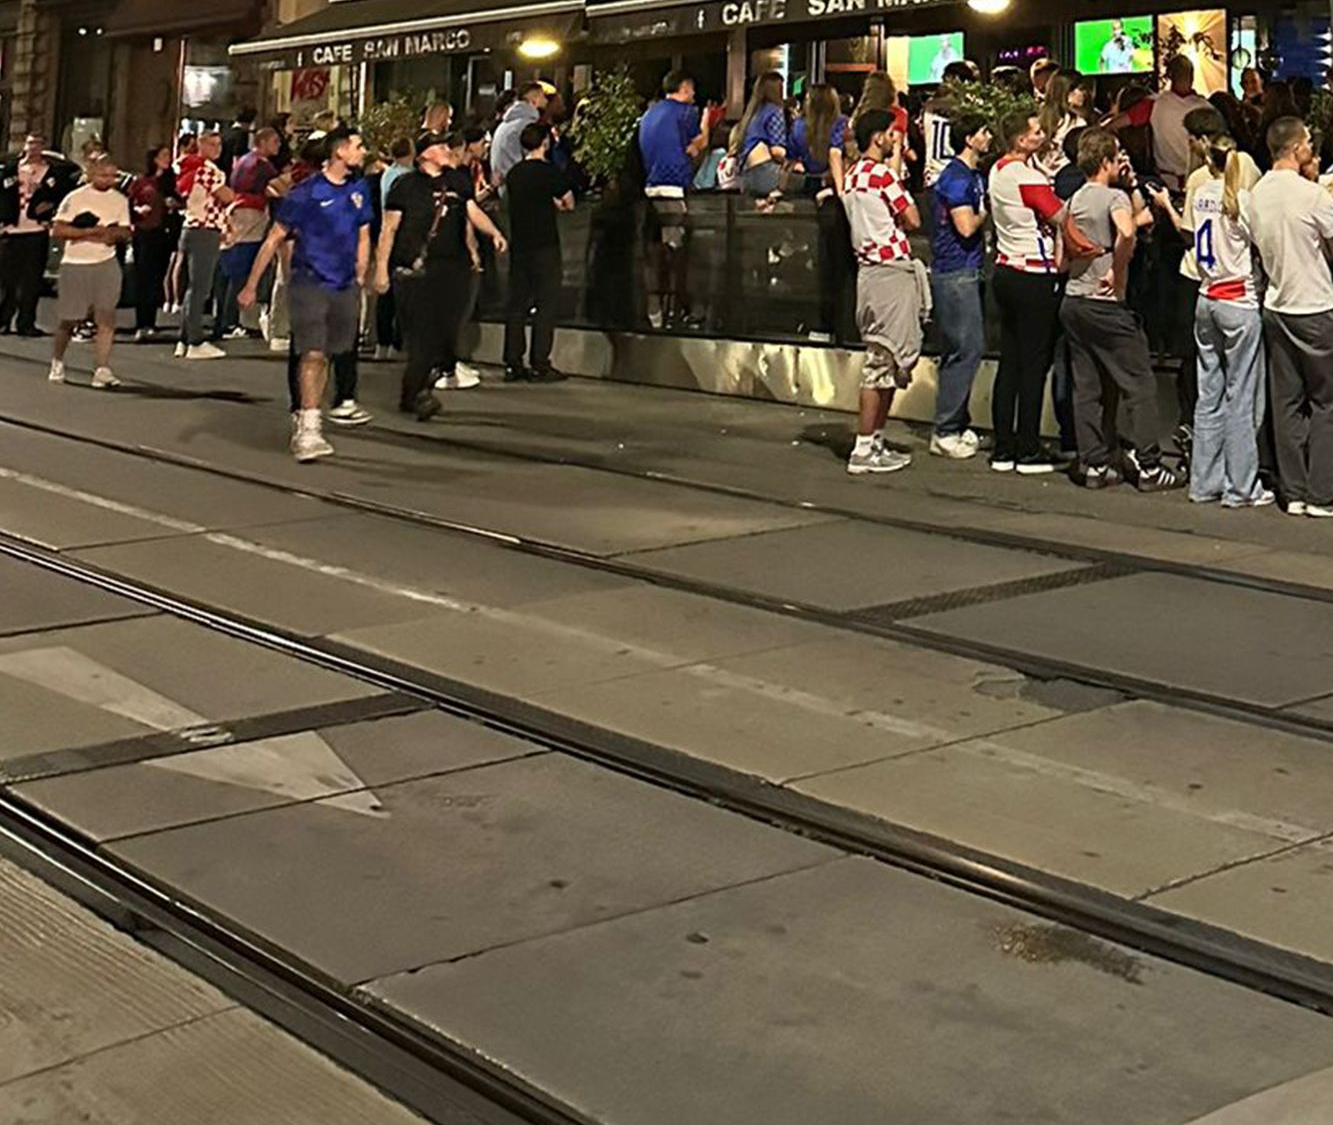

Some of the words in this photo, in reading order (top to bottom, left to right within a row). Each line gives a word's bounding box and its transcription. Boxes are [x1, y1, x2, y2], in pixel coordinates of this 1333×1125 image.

[313, 44, 354, 64] CAFE
[405, 29, 471, 56] MARCO
[1196, 218, 1217, 270] 4
